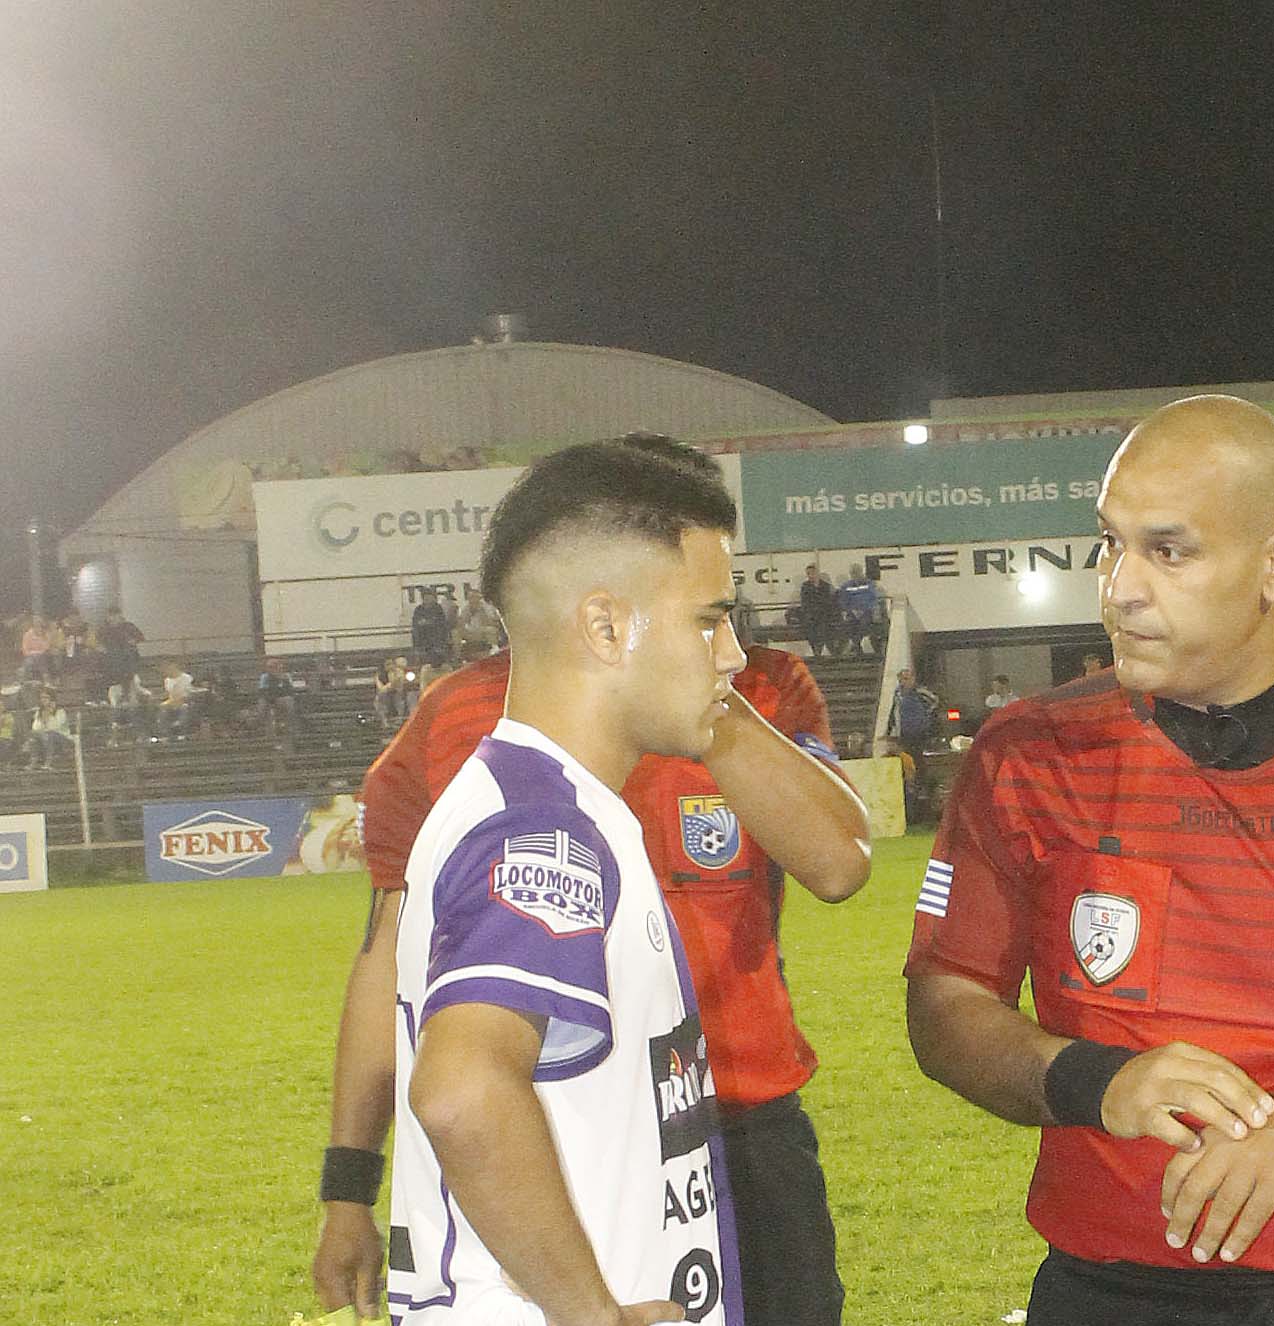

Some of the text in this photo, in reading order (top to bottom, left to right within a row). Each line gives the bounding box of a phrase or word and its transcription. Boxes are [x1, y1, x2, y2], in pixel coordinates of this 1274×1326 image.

[786, 488, 847, 515] más
[854, 484, 991, 513] servicios,
[1000, 477, 1059, 504] más
[163, 828, 270, 857] FENIX
[685, 1263, 708, 1310] 9
